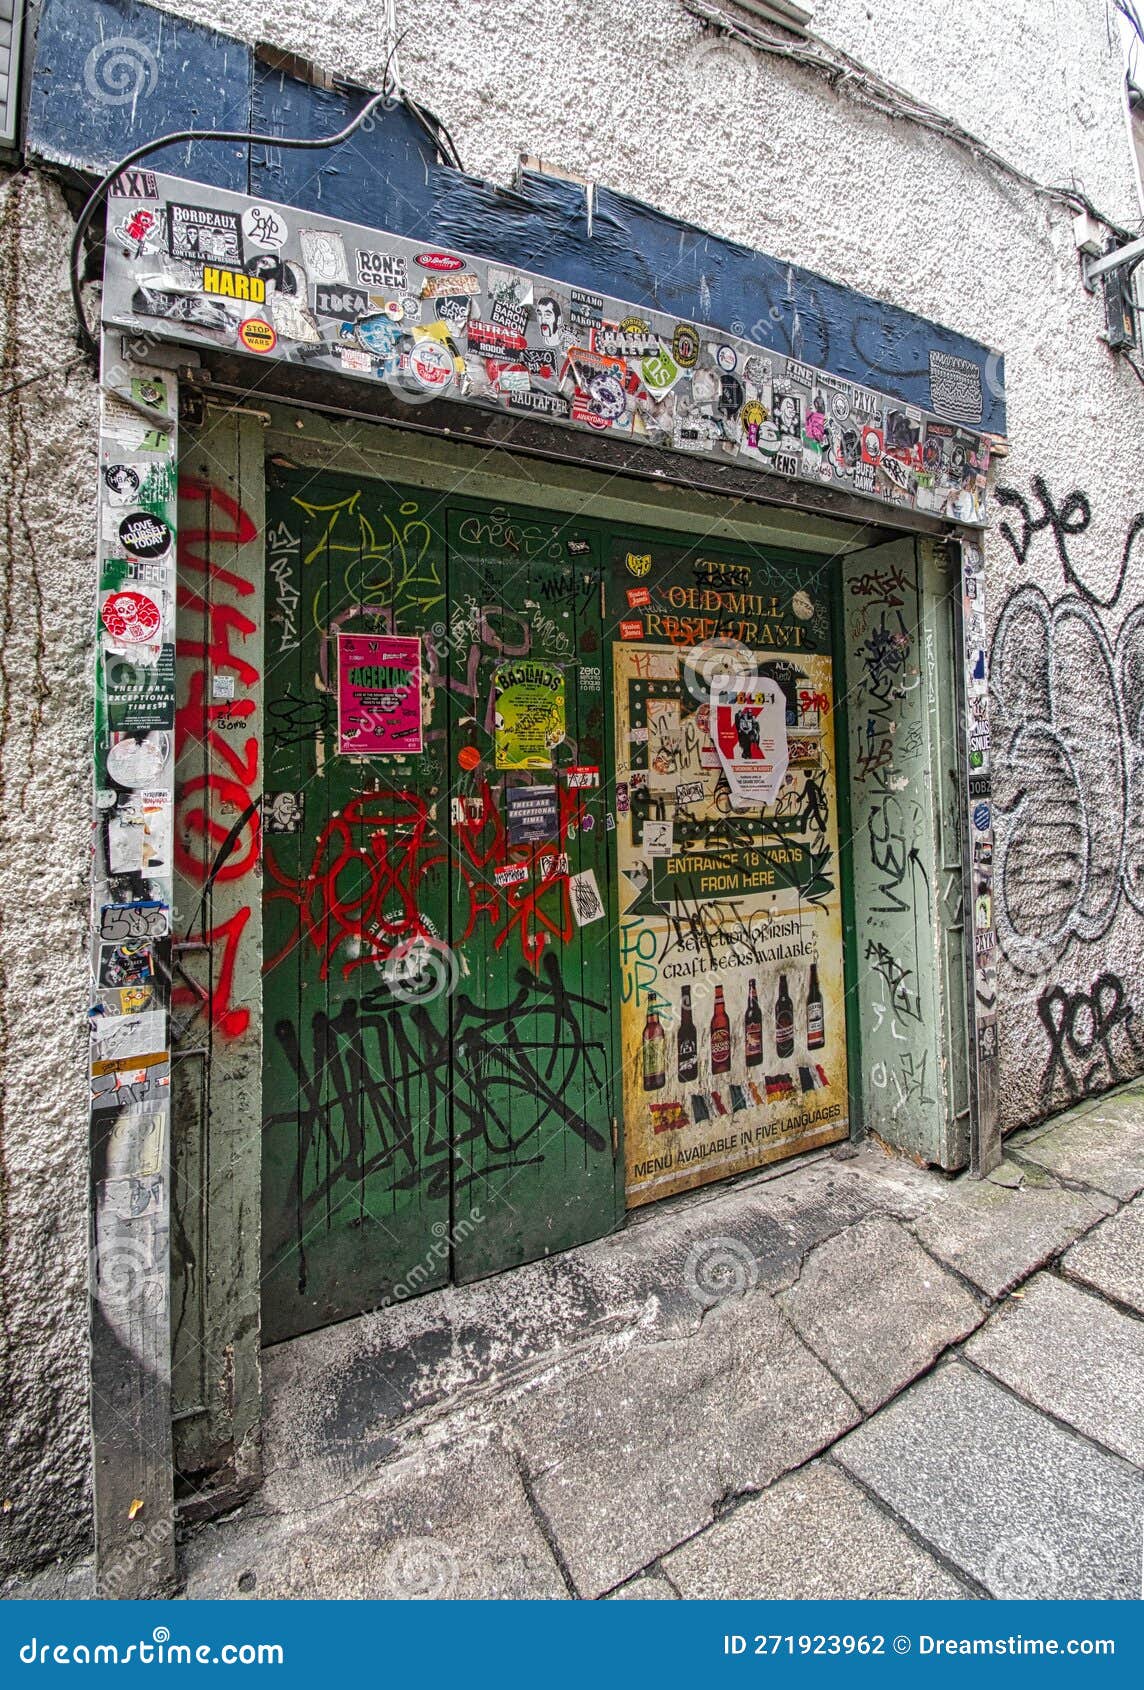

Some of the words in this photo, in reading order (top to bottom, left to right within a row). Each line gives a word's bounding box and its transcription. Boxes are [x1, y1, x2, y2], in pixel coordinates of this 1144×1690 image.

[173, 206, 237, 229] BORDEAUX
[360, 252, 405, 275] RON'S
[204, 266, 265, 303] HARD
[360, 272, 407, 289] CREW
[572, 291, 602, 307] DINAMO
[492, 313, 525, 335] BARON
[494, 304, 527, 326] BARON
[246, 324, 270, 334] STOP
[469, 320, 518, 338] ULTRAS
[247, 337, 270, 346] WARS
[120, 524, 167, 544] YOURSELF
[128, 519, 155, 533] LOVE
[133, 535, 164, 549] TODAY
[669, 585, 721, 612] OLD
[727, 592, 784, 618] MILL
[580, 666, 600, 676] zero
[509, 806, 557, 818] EXCEPTIONAL
[512, 800, 533, 809] THESE
[535, 799, 550, 807] ARE
[667, 854, 739, 874] ENTRANCE
[743, 852, 759, 867] 18
[701, 874, 741, 892] FROM
[743, 871, 775, 888] HERE
[634, 1155, 673, 1178] MENU
[676, 1136, 738, 1163] AVAILABLE
[740, 1132, 752, 1145] IN
[755, 1125, 778, 1140] FIVE
[780, 1104, 841, 1132] LANGUAGES
